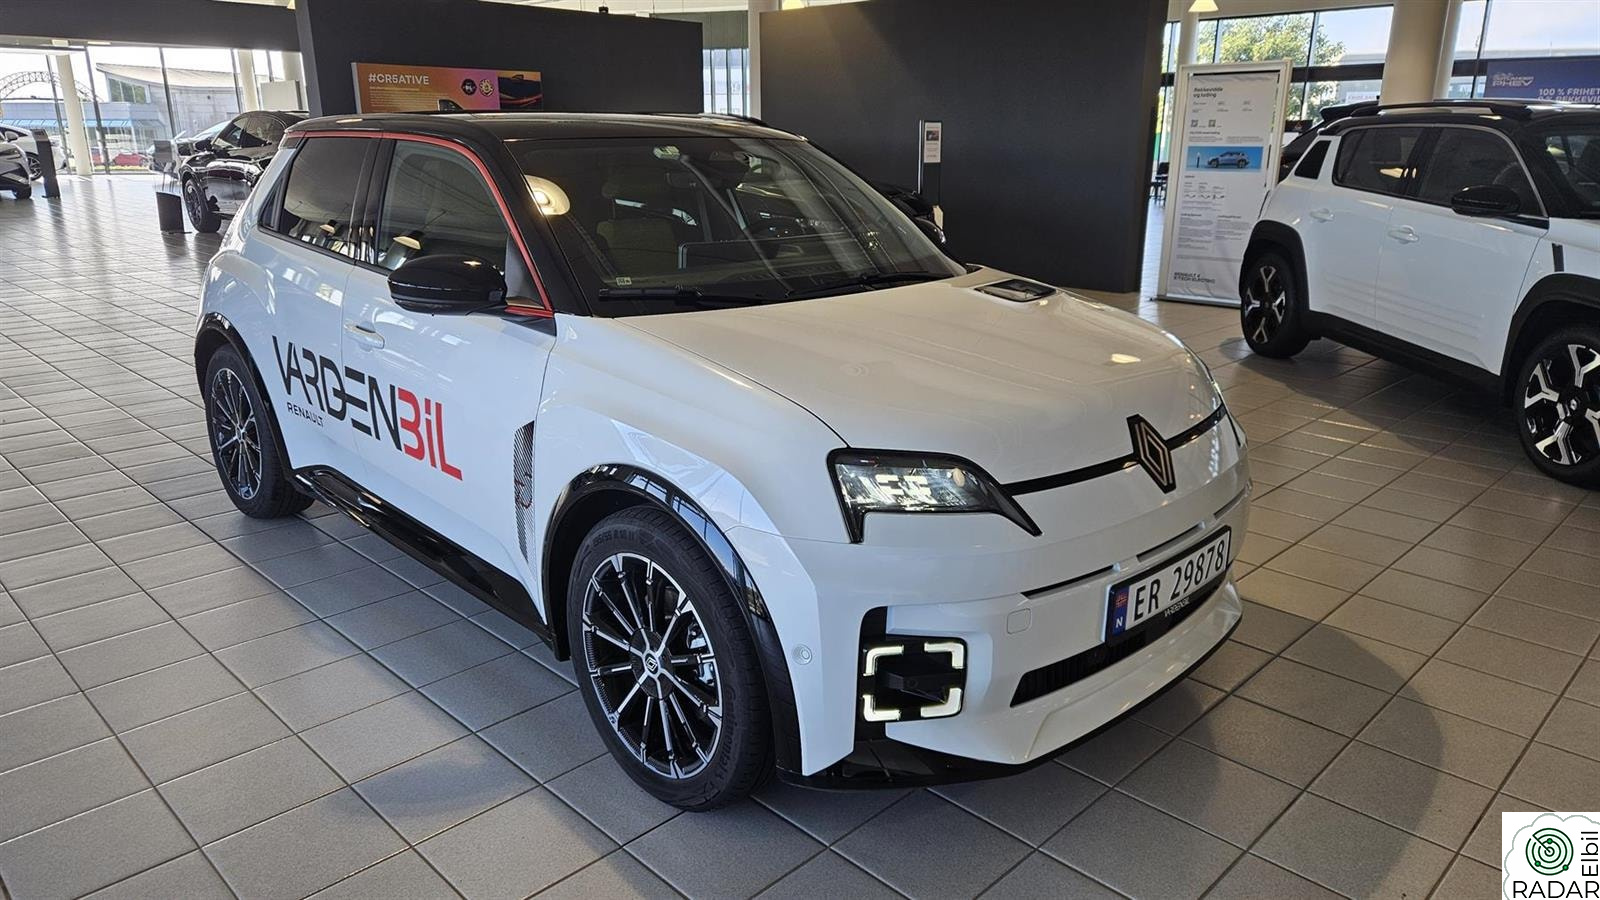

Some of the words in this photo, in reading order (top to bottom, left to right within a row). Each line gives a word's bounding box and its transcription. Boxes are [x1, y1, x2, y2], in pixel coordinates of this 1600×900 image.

[368, 72, 430, 85] #CR5ATIVE
[1538, 88, 1555, 96] 100
[1557, 88, 1565, 96] %
[286, 401, 325, 428] RENAULT
[1133, 578, 1161, 622] ER
[1170, 539, 1225, 602] 29878
[1115, 616, 1123, 628] N
